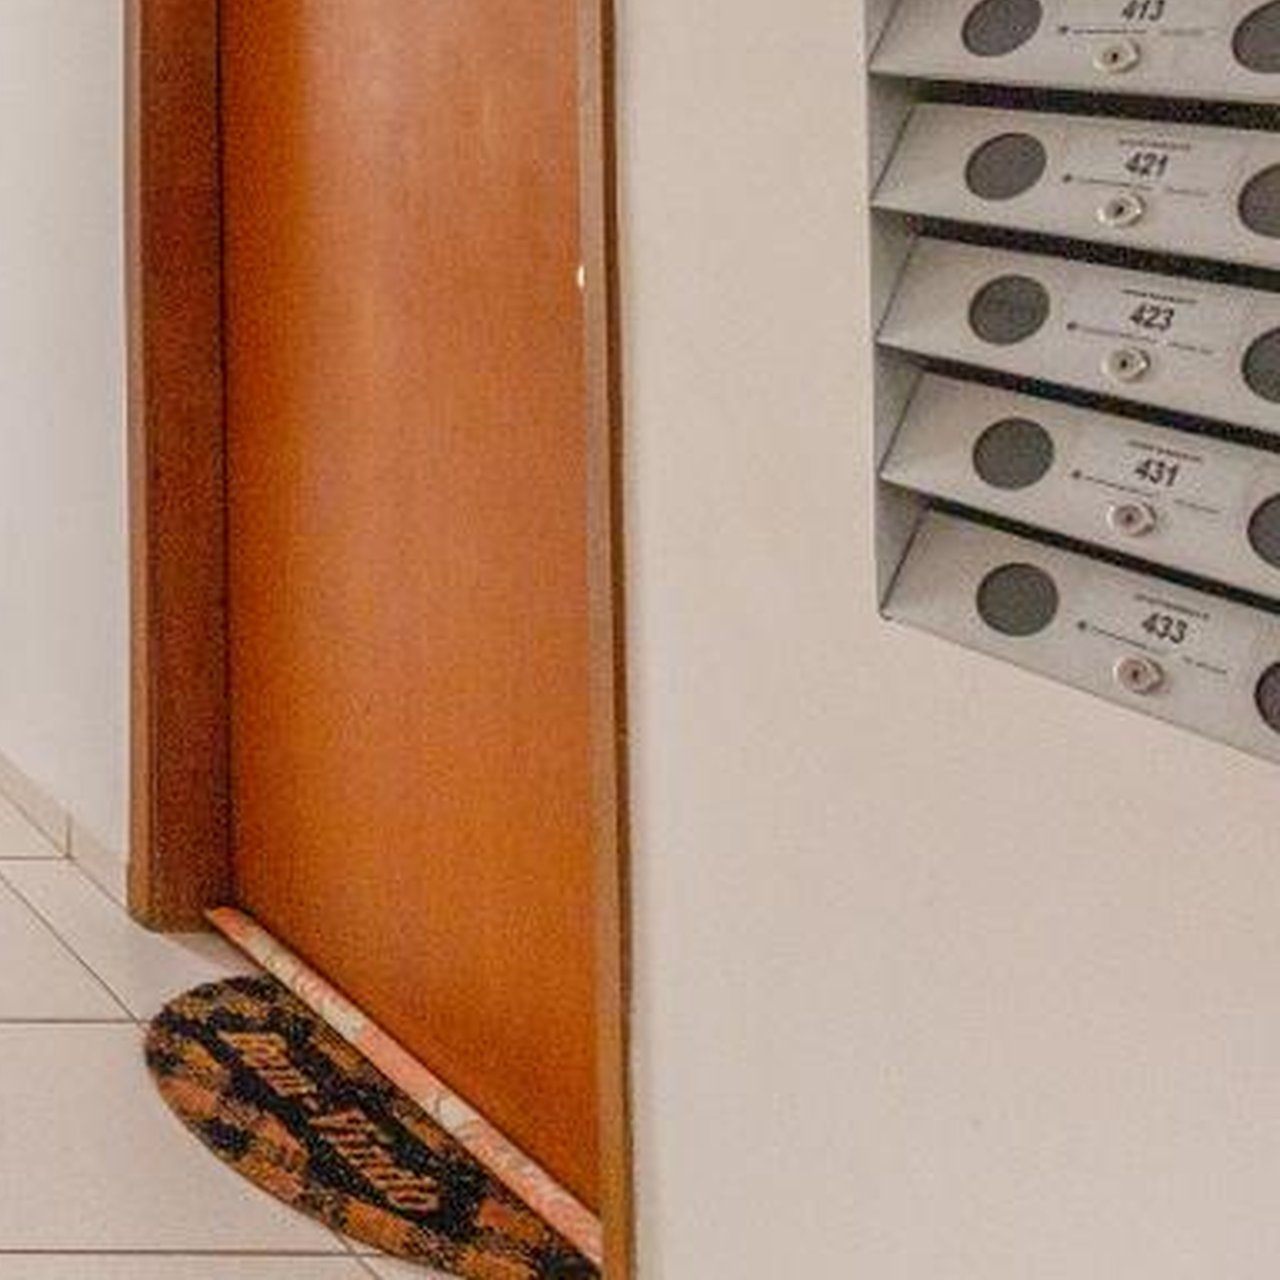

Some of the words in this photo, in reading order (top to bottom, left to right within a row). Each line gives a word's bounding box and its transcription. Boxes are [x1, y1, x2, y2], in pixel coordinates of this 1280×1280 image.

[1121, 0, 1166, 22] 413
[1125, 152, 1169, 176] 421
[1129, 304, 1175, 332] 423
[1134, 459, 1179, 487] 431
[1142, 613, 1188, 644] 433
